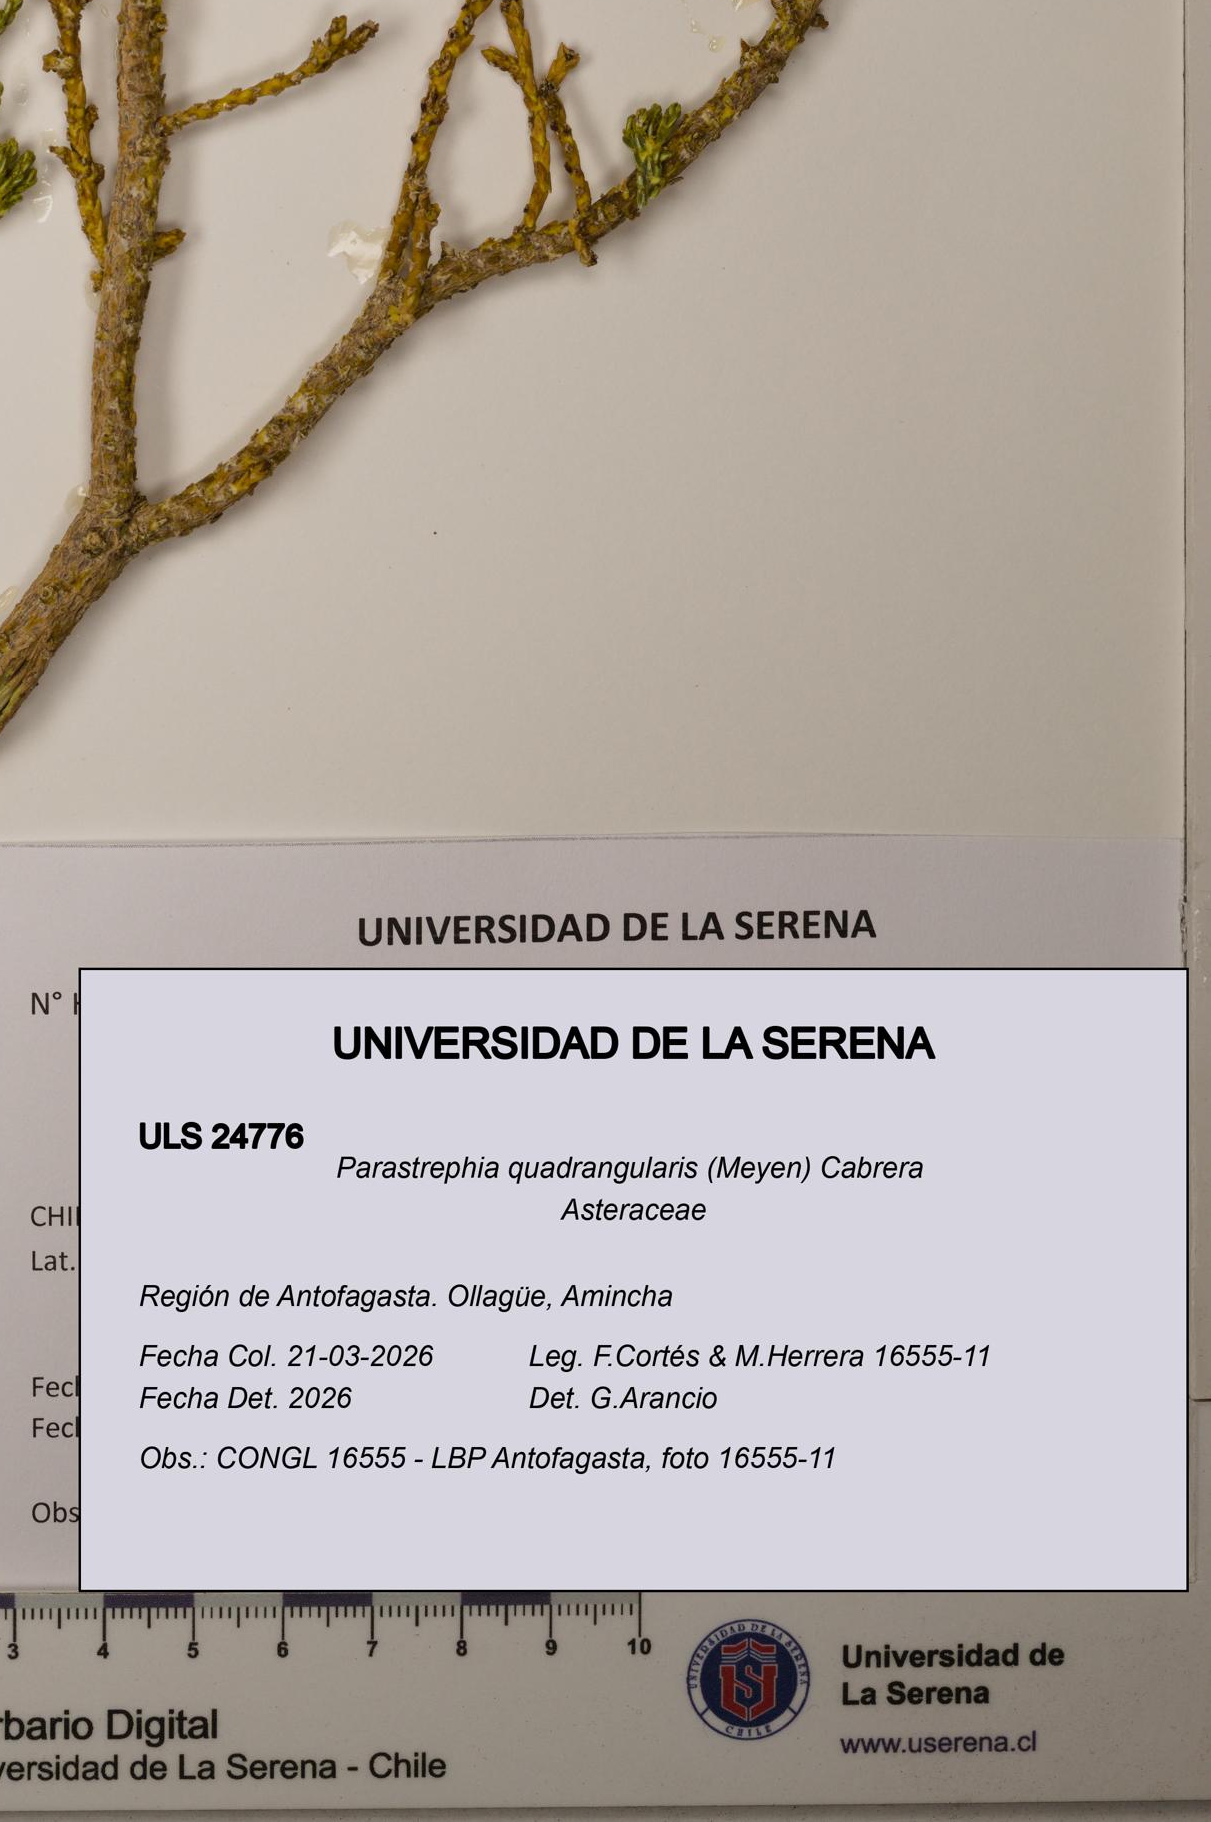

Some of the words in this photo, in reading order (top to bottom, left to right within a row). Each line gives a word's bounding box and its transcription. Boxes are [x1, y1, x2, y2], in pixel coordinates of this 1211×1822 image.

[357, 912, 611, 947] UNIVERSIDAD
[623, 912, 669, 942] DE
[681, 911, 726, 941] LA
[734, 909, 877, 941] SERENA
[31, 1250, 76, 1272] Lat.
[32, 1374, 79, 1398] Fec
[32, 1415, 79, 1439] Fec
[7, 1642, 20, 1660] 3
[96, 1642, 110, 1660] 4
[187, 1642, 200, 1659] 5
[276, 1641, 289, 1659] 6
[366, 1640, 379, 1658] 7
[455, 1640, 468, 1657] 8
[544, 1639, 558, 1657] 9
[627, 1638, 652, 1656] 10
[842, 1641, 1020, 1667] Universidad
[1028, 1641, 1066, 1667] de
[841, 1680, 877, 1706] La
[885, 1680, 990, 1706] Serena
[106, 1708, 218, 1747] Digital
[839, 1730, 1038, 1755] www.userena.cl
[129, 1753, 168, 1781] de
[178, 1753, 216, 1781] La
[226, 1752, 337, 1781] Serena
[368, 1751, 447, 1780] Chile
